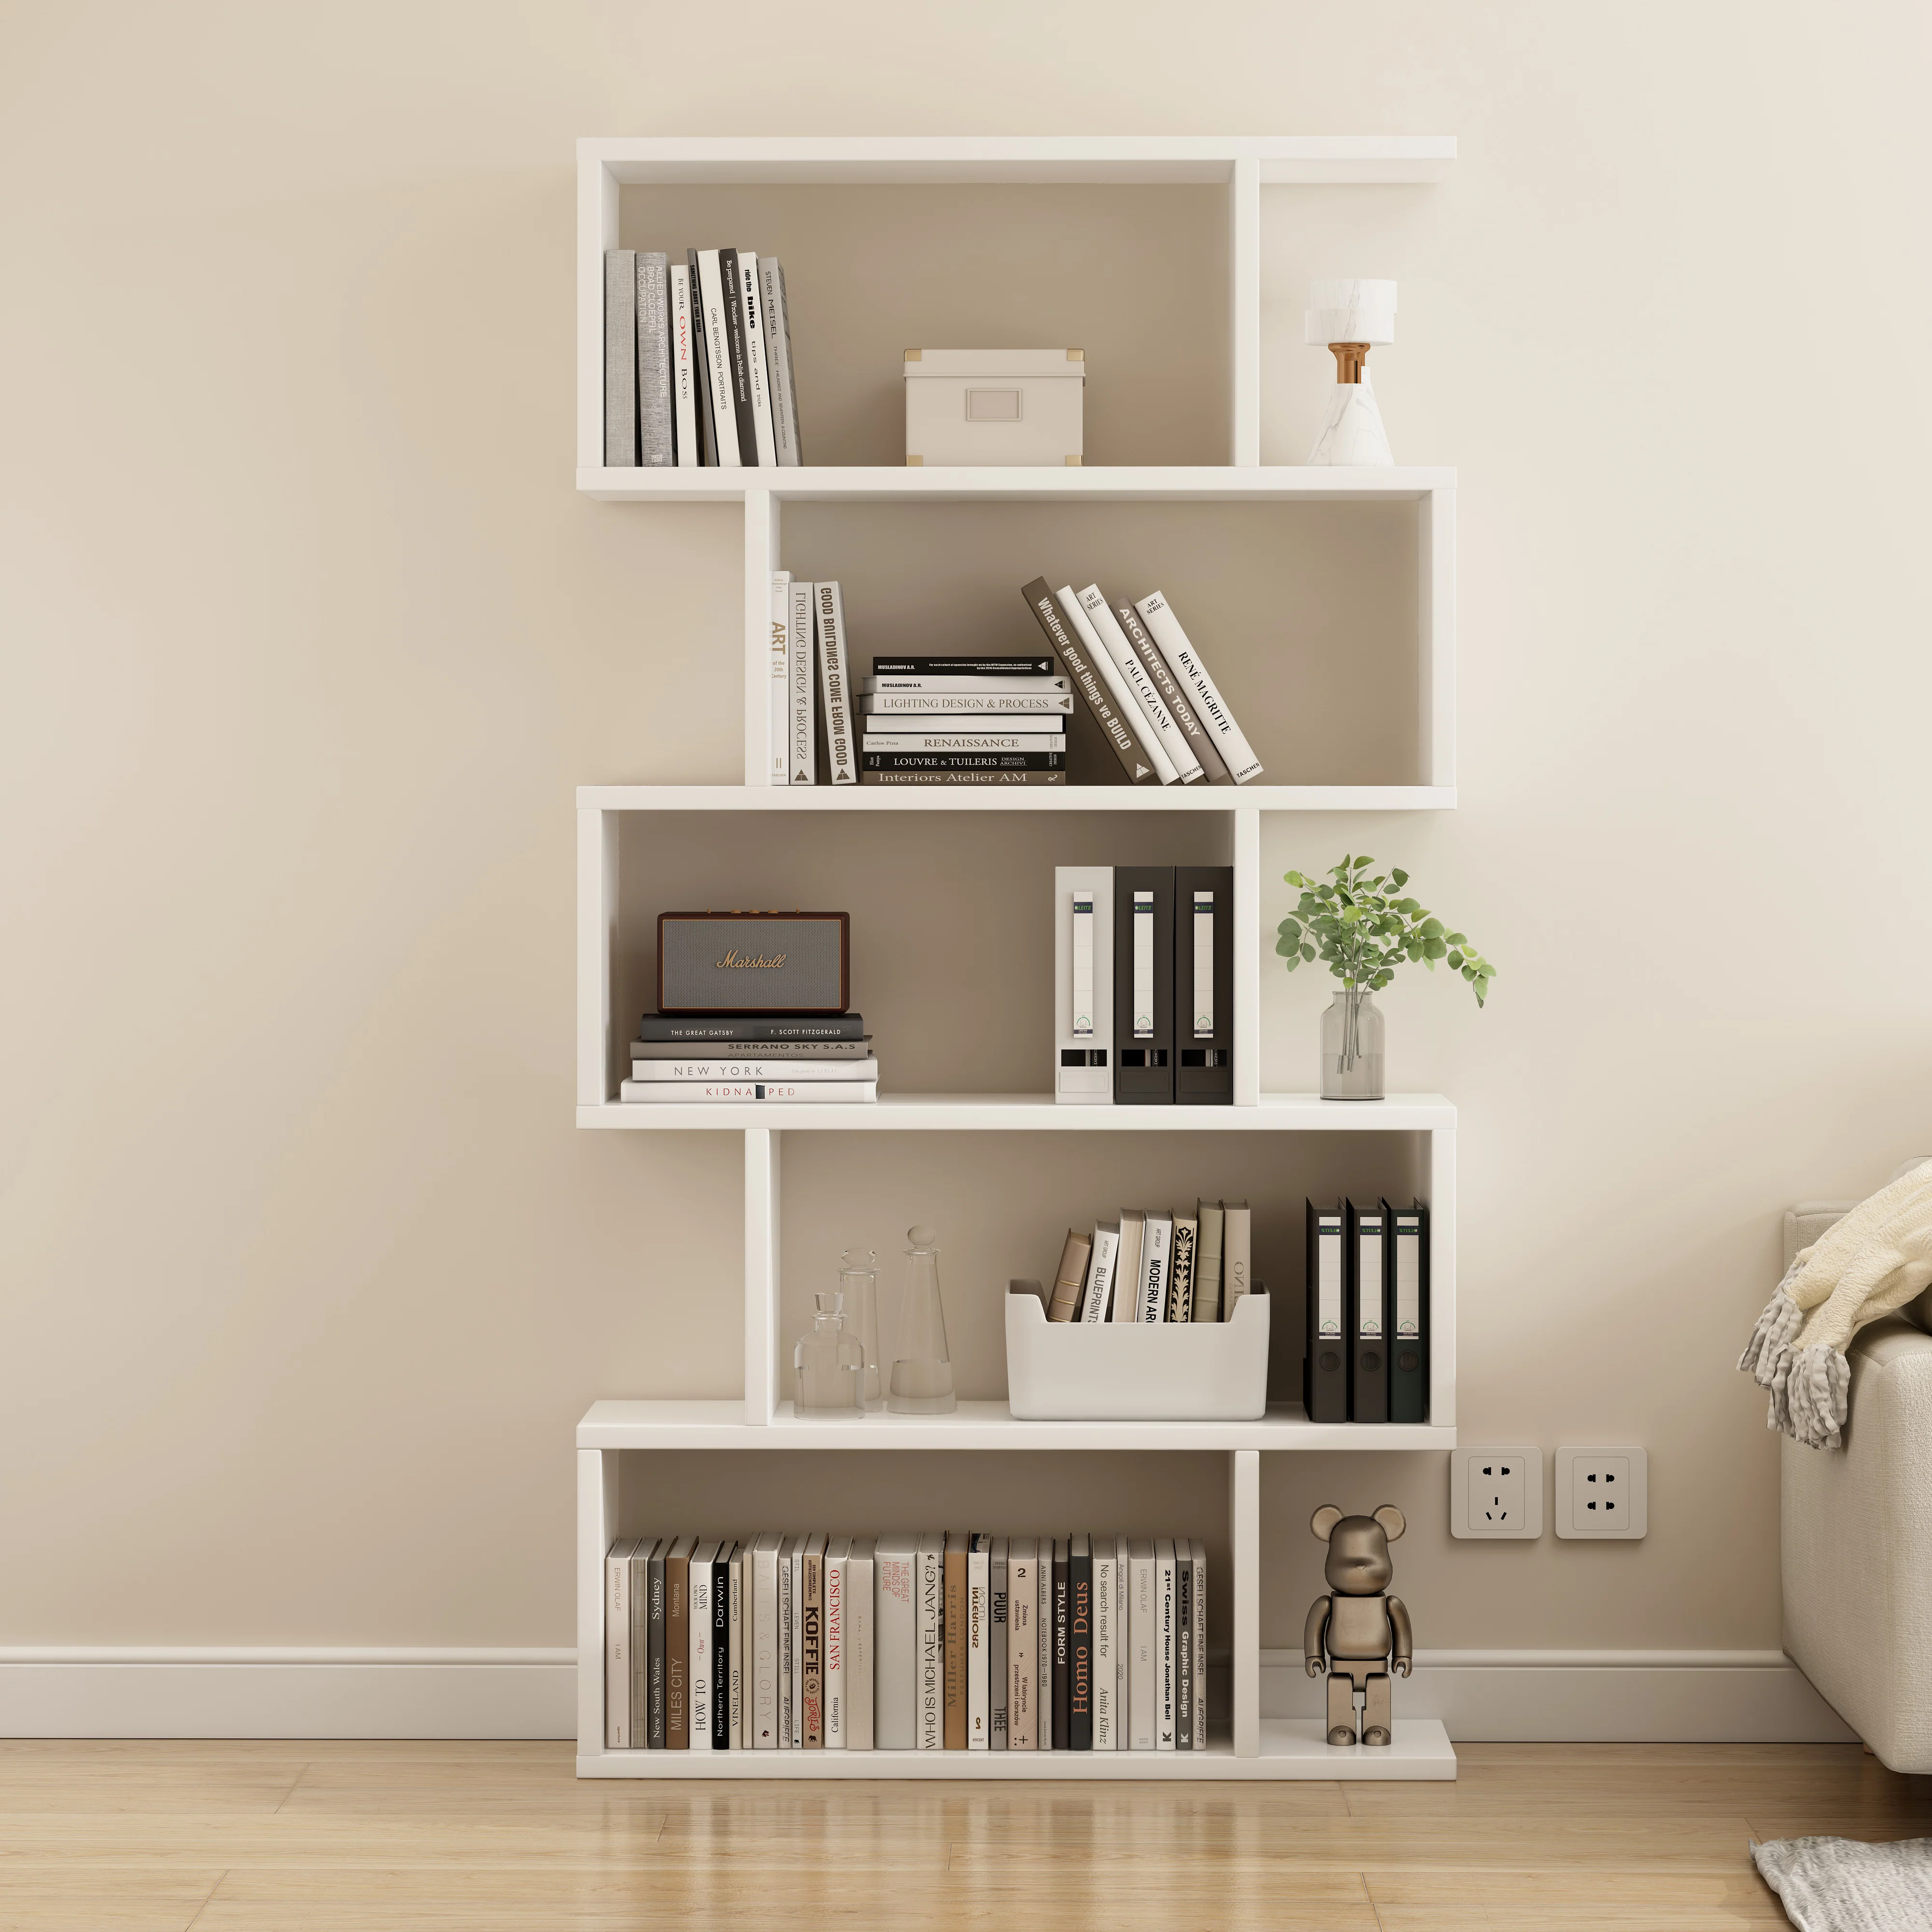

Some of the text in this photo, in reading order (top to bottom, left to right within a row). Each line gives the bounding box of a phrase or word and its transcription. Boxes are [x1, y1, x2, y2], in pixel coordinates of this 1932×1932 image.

[726, 268, 735, 294] prepared
[768, 299, 778, 339] MEISEL
[713, 327, 723, 368] BENGTSSON
[718, 372, 726, 410] PORTRAITS
[1085, 592, 1096, 602] ART
[1087, 597, 1104, 611] SERIES
[1146, 602, 1165, 614] SERIES
[1147, 599, 1158, 608] ART
[772, 621, 785, 654] ART
[1038, 597, 1132, 750] Whatever good things ve BUILD
[1119, 609, 1201, 737] ARCHITECTS TODAY
[884, 699, 1049, 708] LIGHTING DESIGN & PROCESS
[1125, 660, 1171, 732] PAUL CÉZANNE
[1178, 652, 1231, 735] RENÉ MAGRITTE
[924, 739, 1019, 747] RENAISSANCE
[894, 758, 938, 766] LOUVRE
[949, 758, 997, 766] TUILERIS
[1181, 765, 1202, 779] TASCHEN
[1236, 762, 1260, 778] TASCHEN
[879, 773, 1027, 781] Interiors Atelier AM
[717, 950, 786, 968] Marshall
[675, 1066, 763, 1076] NEW YORK
[1147, 1260, 1161, 1303] MODERN
[1100, 1565, 1108, 1578] No
[652, 1577, 662, 1619] Sydney
[1100, 1580, 1108, 1612] search
[830, 1570, 840, 1669] SAN FRANCISCO
[1100, 1615, 1108, 1641] result
[806, 1607, 819, 1675] KOFFIE
[1073, 1582, 1088, 1714] Homo Deus
[925, 1565, 936, 1748] WHO IS MICHAEL JANG?
[671, 1658, 682, 1730] MILES CITY
[696, 1679, 706, 1731] HOW TO
[1100, 1688, 1108, 1714] Anita
[804, 1697, 821, 1732] STORIES
[1100, 1717, 1108, 1744] Klinz
